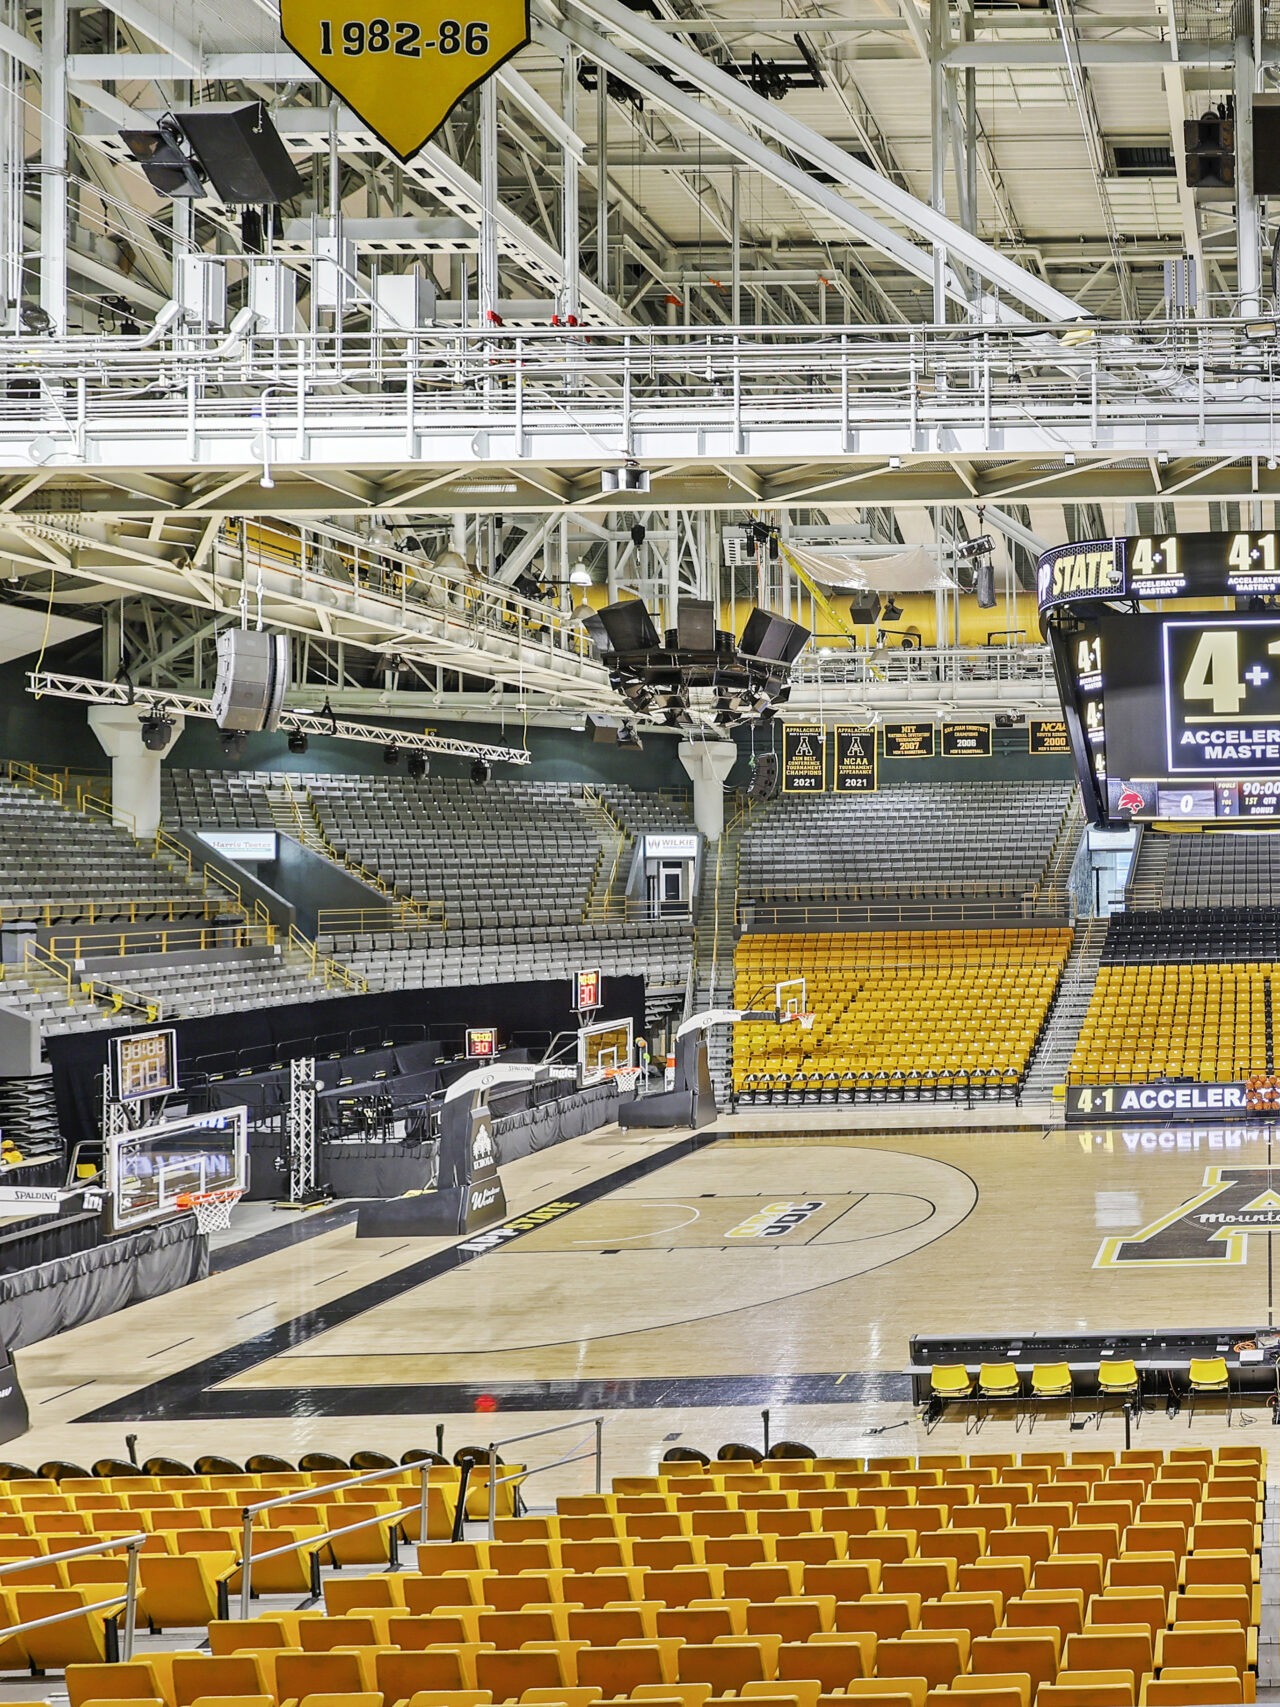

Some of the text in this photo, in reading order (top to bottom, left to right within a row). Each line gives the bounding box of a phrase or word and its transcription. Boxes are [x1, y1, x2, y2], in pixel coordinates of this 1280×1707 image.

[319, 18, 490, 58] 1982-86
[1052, 549, 1117, 596] STATE
[1131, 579, 1186, 589] ACCELERATED
[1236, 583, 1277, 592] MASTER'S
[1139, 586, 1179, 595] MASTER'S
[900, 742, 920, 750] 2007
[843, 757, 868, 765] NCAA
[793, 778, 815, 787] 2021
[845, 778, 867, 787] 2021
[1223, 789, 1229, 798] 0
[1180, 795, 1194, 813] 0
[1245, 796, 1277, 805] 1ST QTR
[1223, 806, 1230, 815] 4
[1250, 806, 1274, 814] BONUS
[580, 985, 594, 1005] 30
[475, 1042, 489, 1052] 30
[1077, 1088, 1114, 1112] 4+1
[15, 1191, 57, 1201] SPALDING
[456, 1202, 581, 1252] APP STATE
